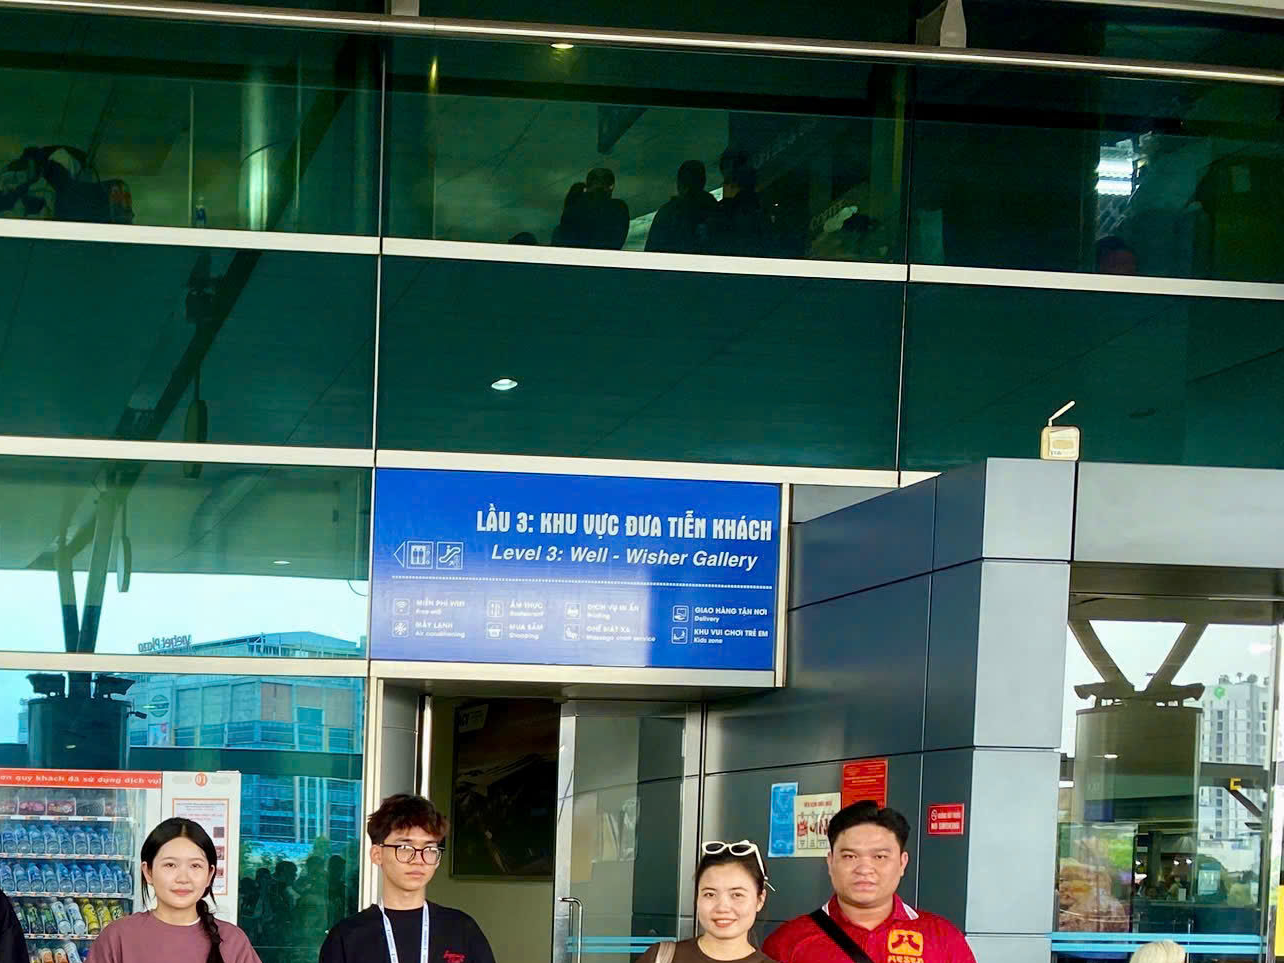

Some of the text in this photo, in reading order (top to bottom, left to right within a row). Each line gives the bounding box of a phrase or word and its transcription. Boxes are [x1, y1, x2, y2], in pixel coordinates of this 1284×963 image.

[476, 503, 772, 541] LẦU 3: KHU VỰC ĐƯA TIỄN KHÁCH
[491, 544, 542, 561] Level
[547, 546, 564, 562] 3:
[570, 547, 608, 563] Well
[626, 549, 687, 567] Wisher
[692, 551, 758, 571] Gallery
[715, 606, 737, 615] HÀNG
